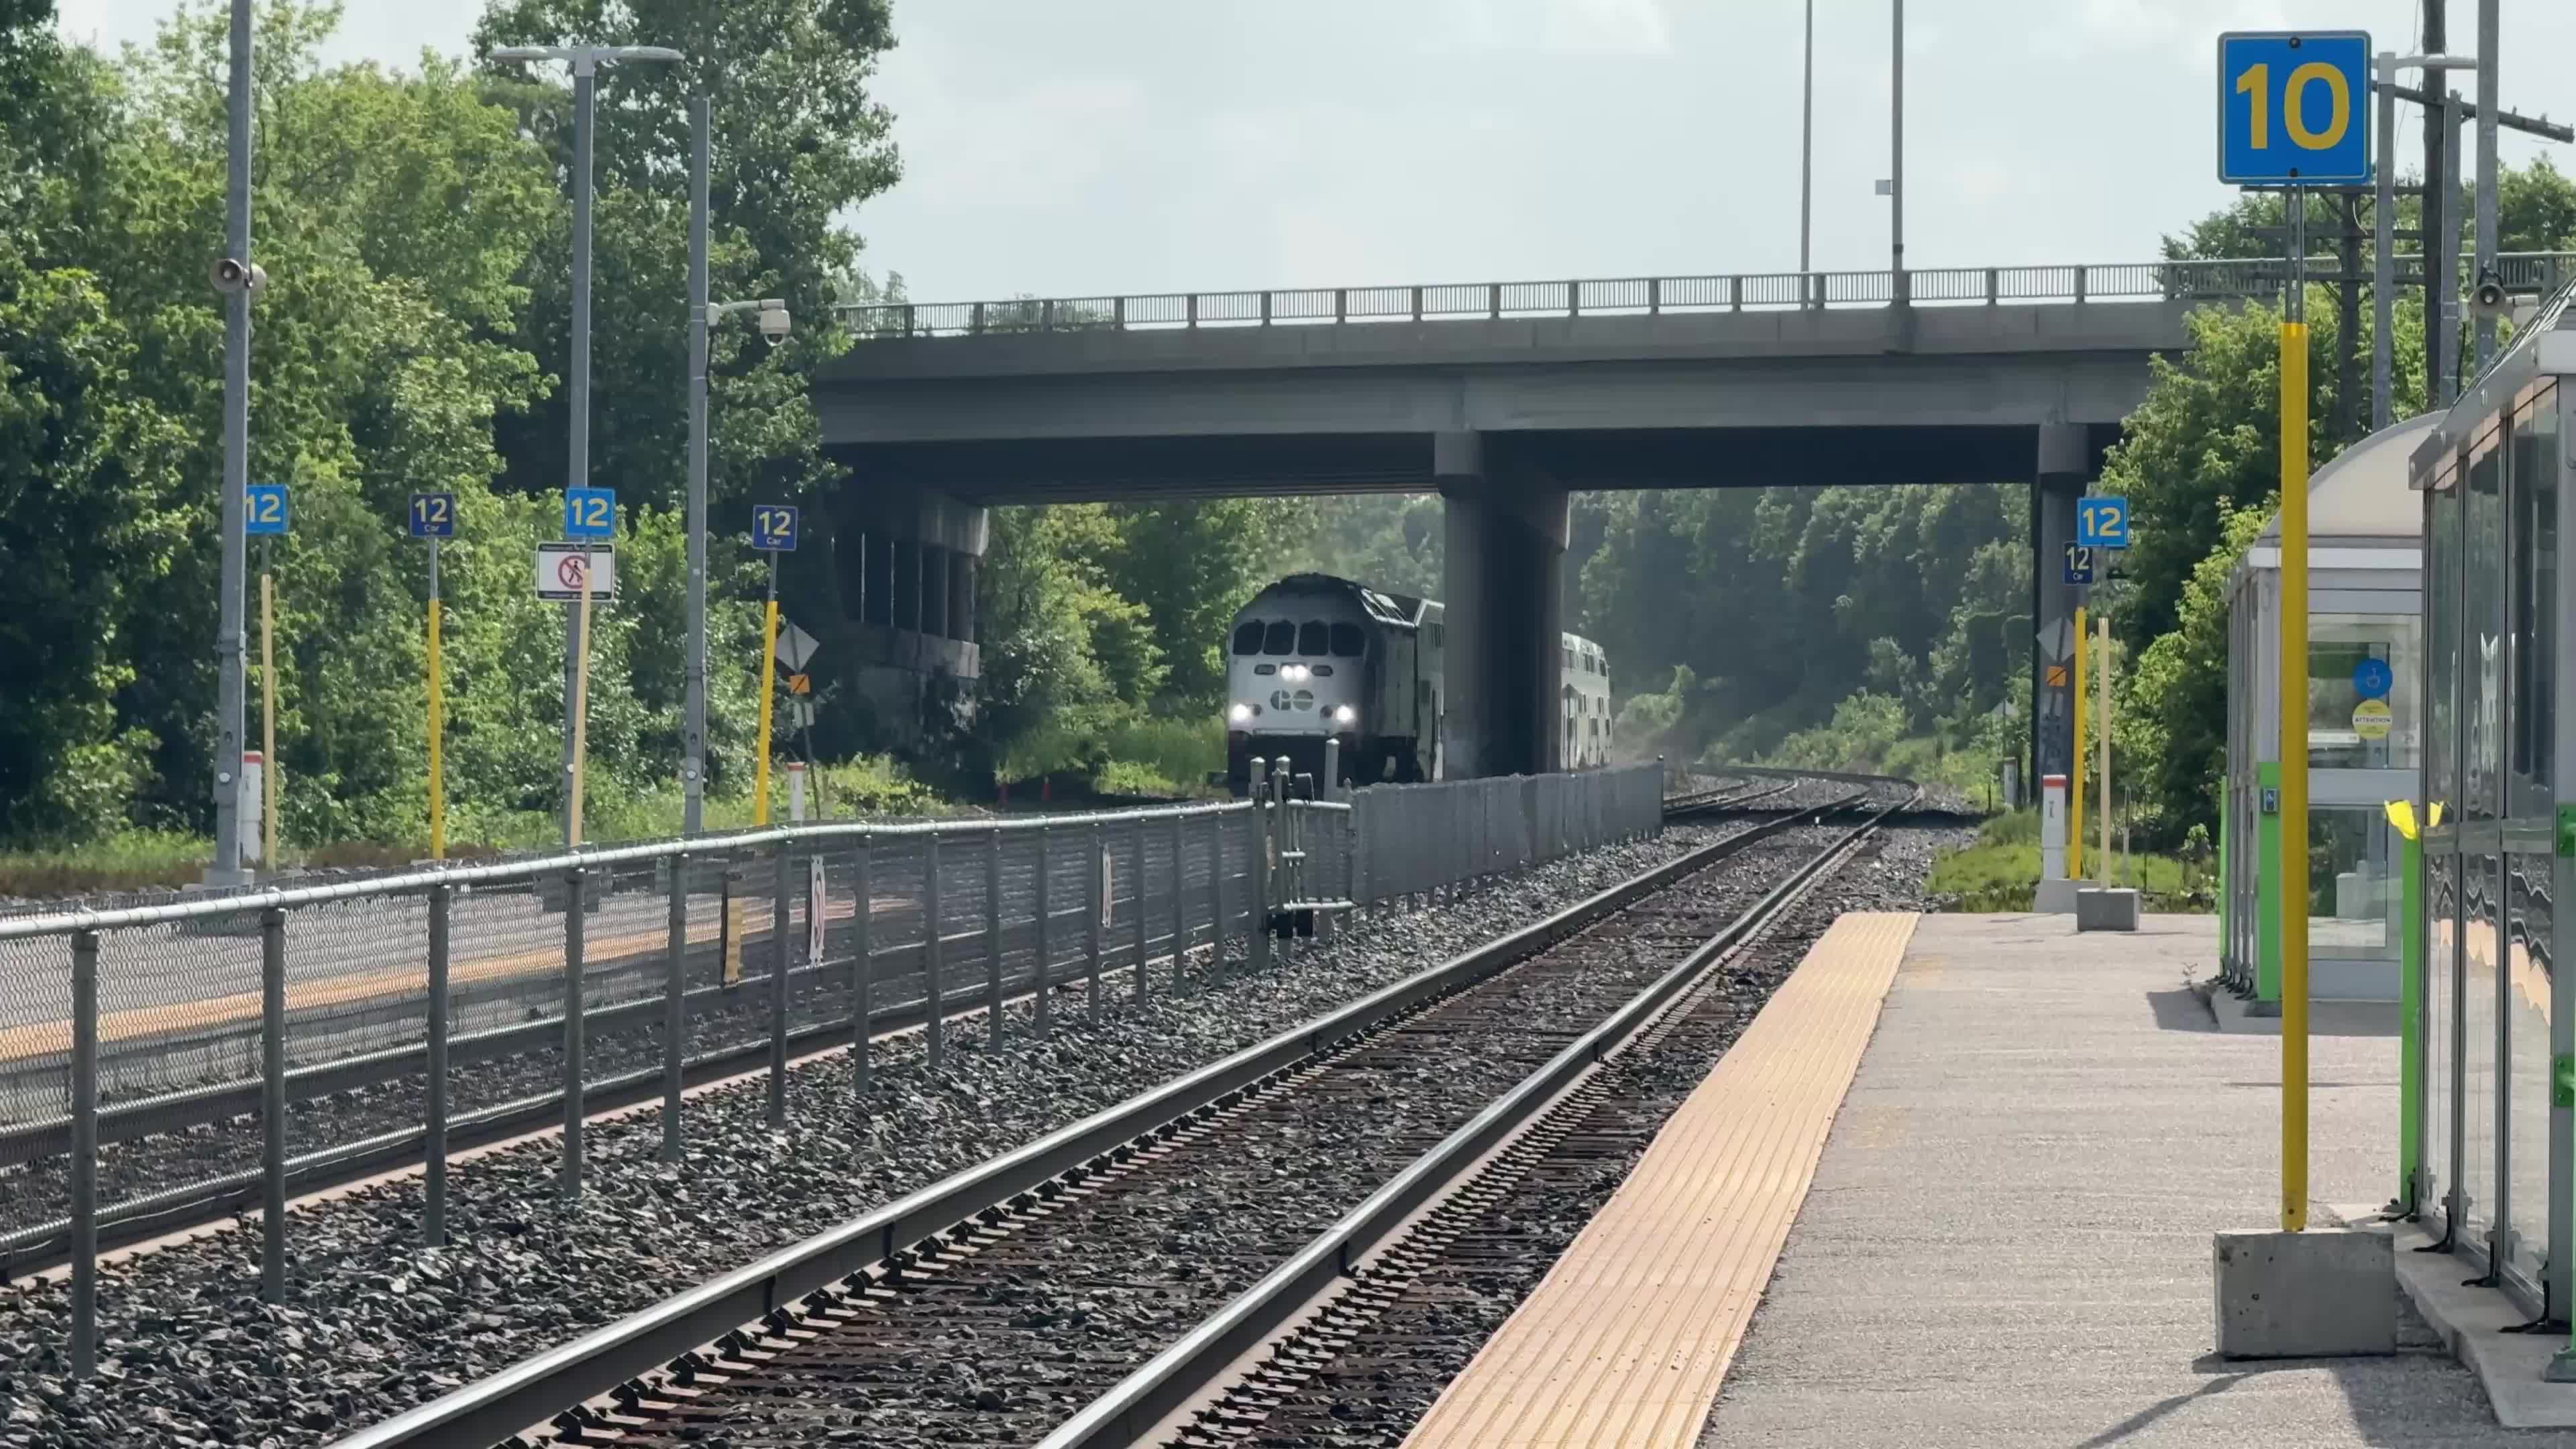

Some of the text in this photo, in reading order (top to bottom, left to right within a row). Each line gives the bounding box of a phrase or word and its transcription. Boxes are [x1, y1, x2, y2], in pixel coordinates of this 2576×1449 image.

[2236, 62, 2350, 150] 10
[246, 494, 280, 523] 12
[415, 498, 447, 523] 12
[572, 497, 608, 527] 12
[2082, 507, 2122, 537] 12
[758, 511, 790, 536] 12
[766, 536, 782, 545] Car
[2066, 546, 2090, 570] 12
